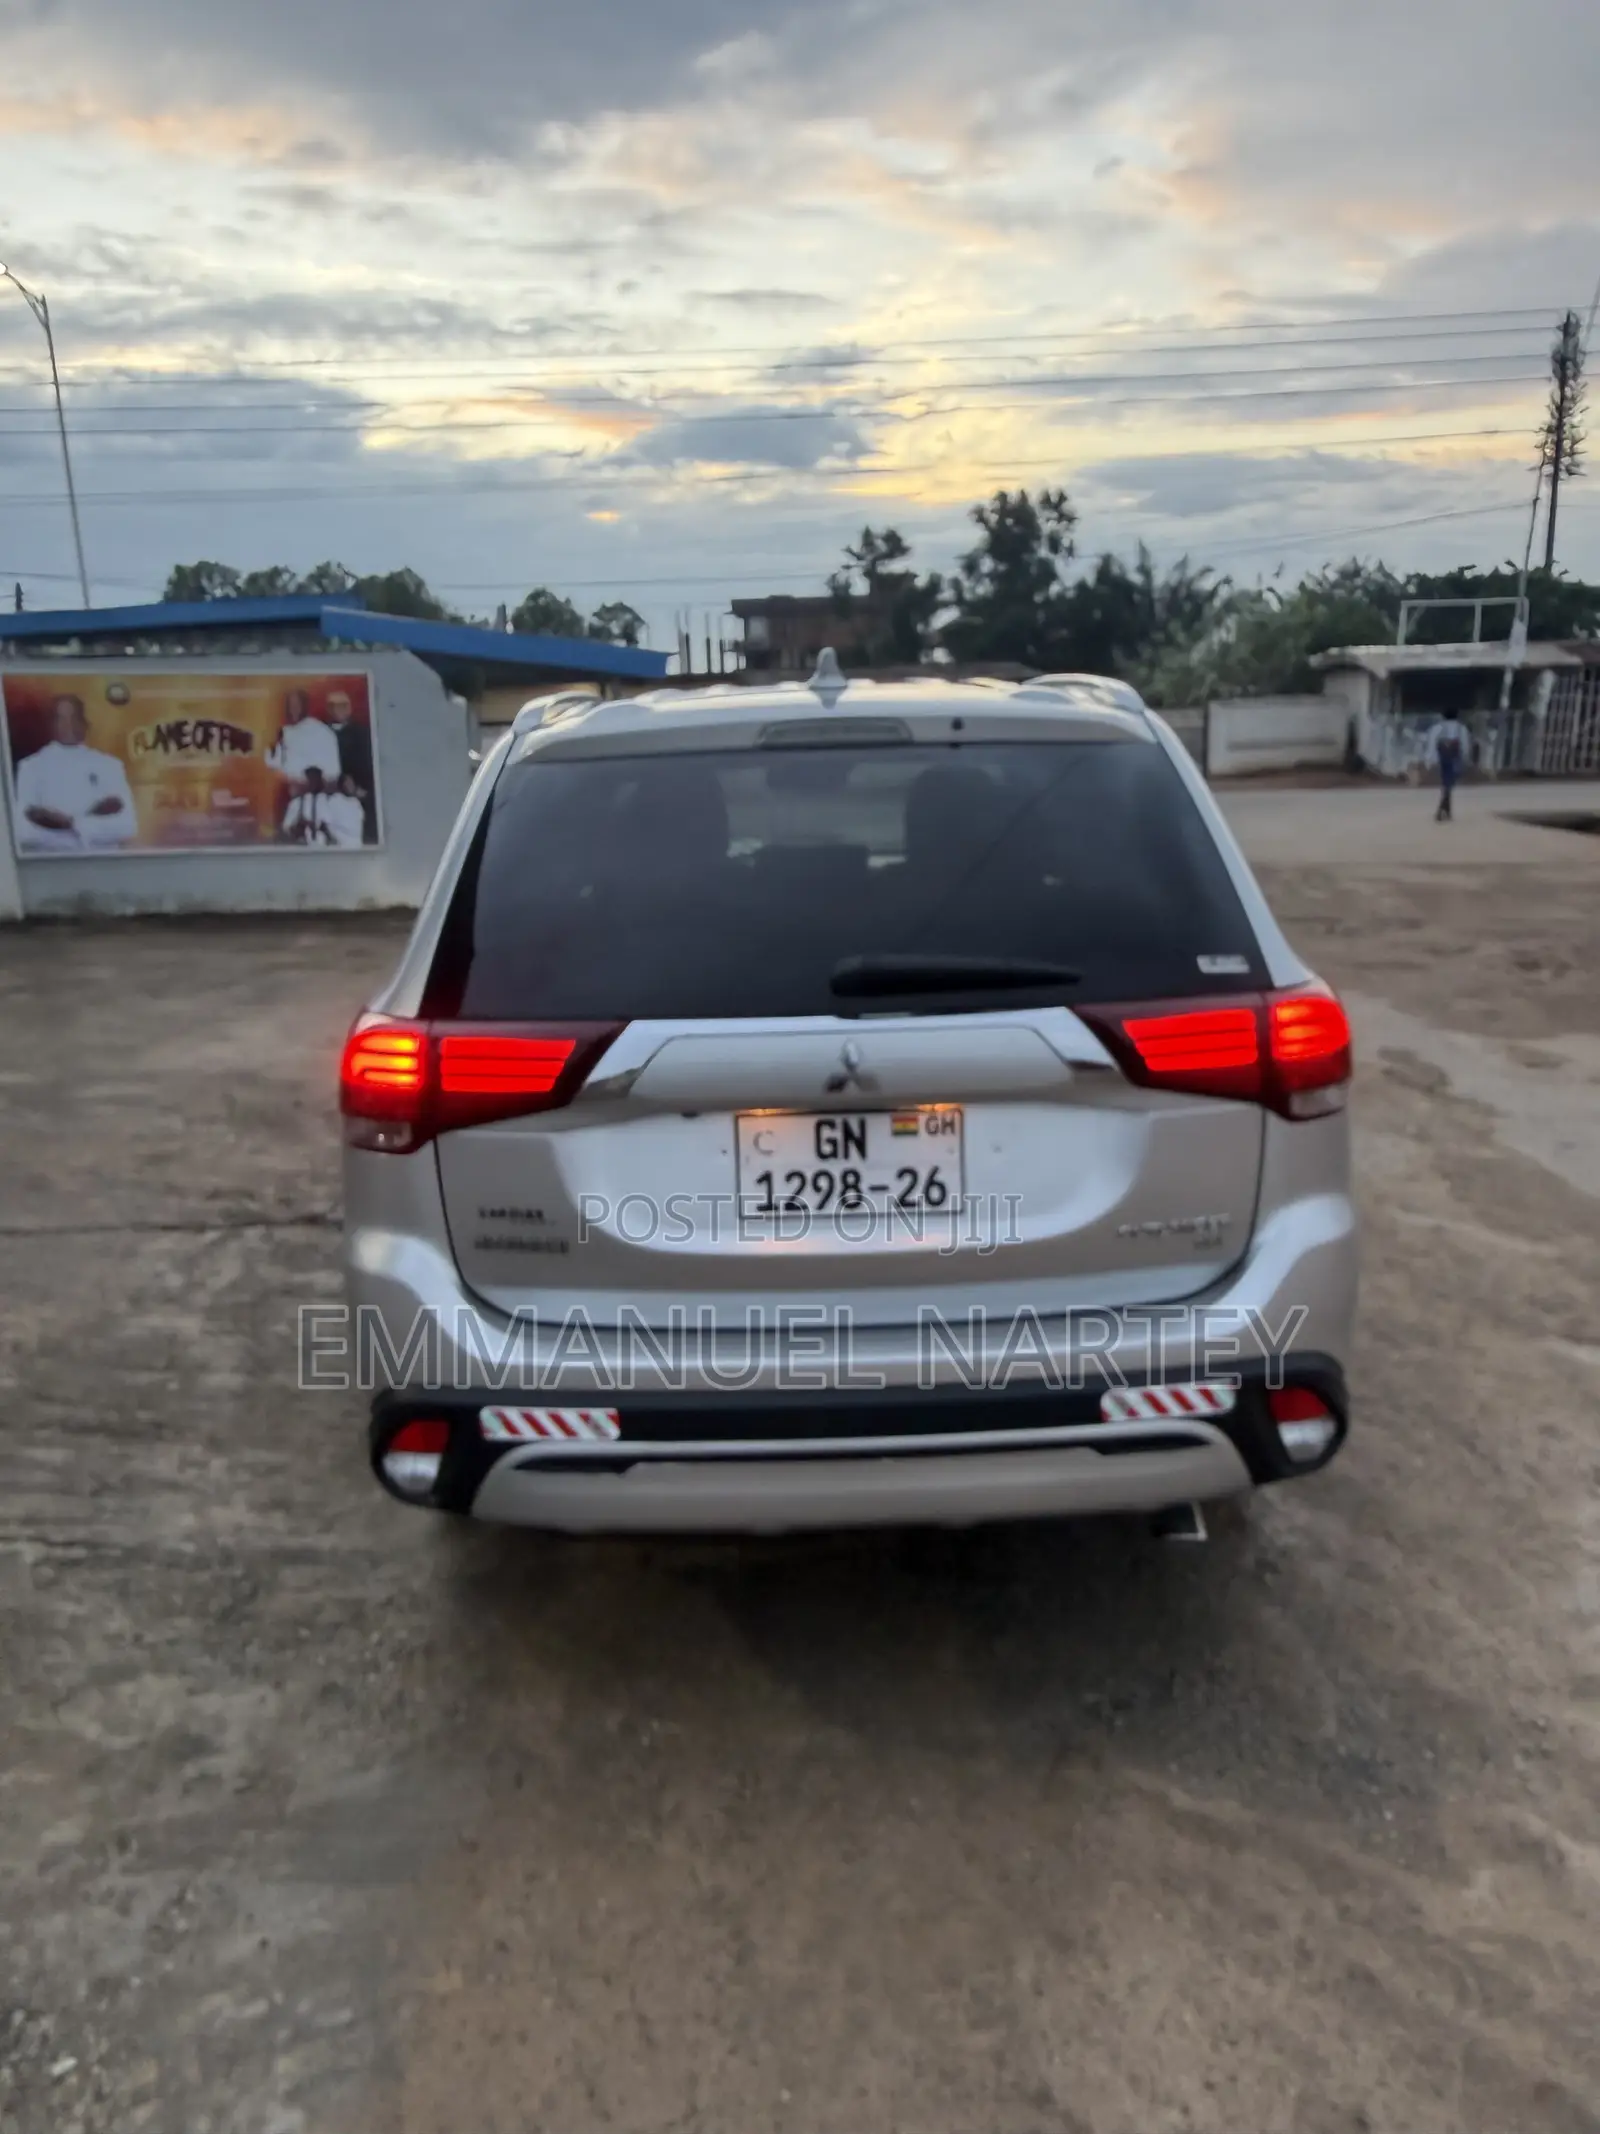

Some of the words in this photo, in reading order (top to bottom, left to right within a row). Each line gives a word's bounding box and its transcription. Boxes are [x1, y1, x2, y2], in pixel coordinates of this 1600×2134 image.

[814, 1118, 867, 1161] GN
[925, 1115, 956, 1136] GH
[756, 1165, 947, 1212] 1298-26
